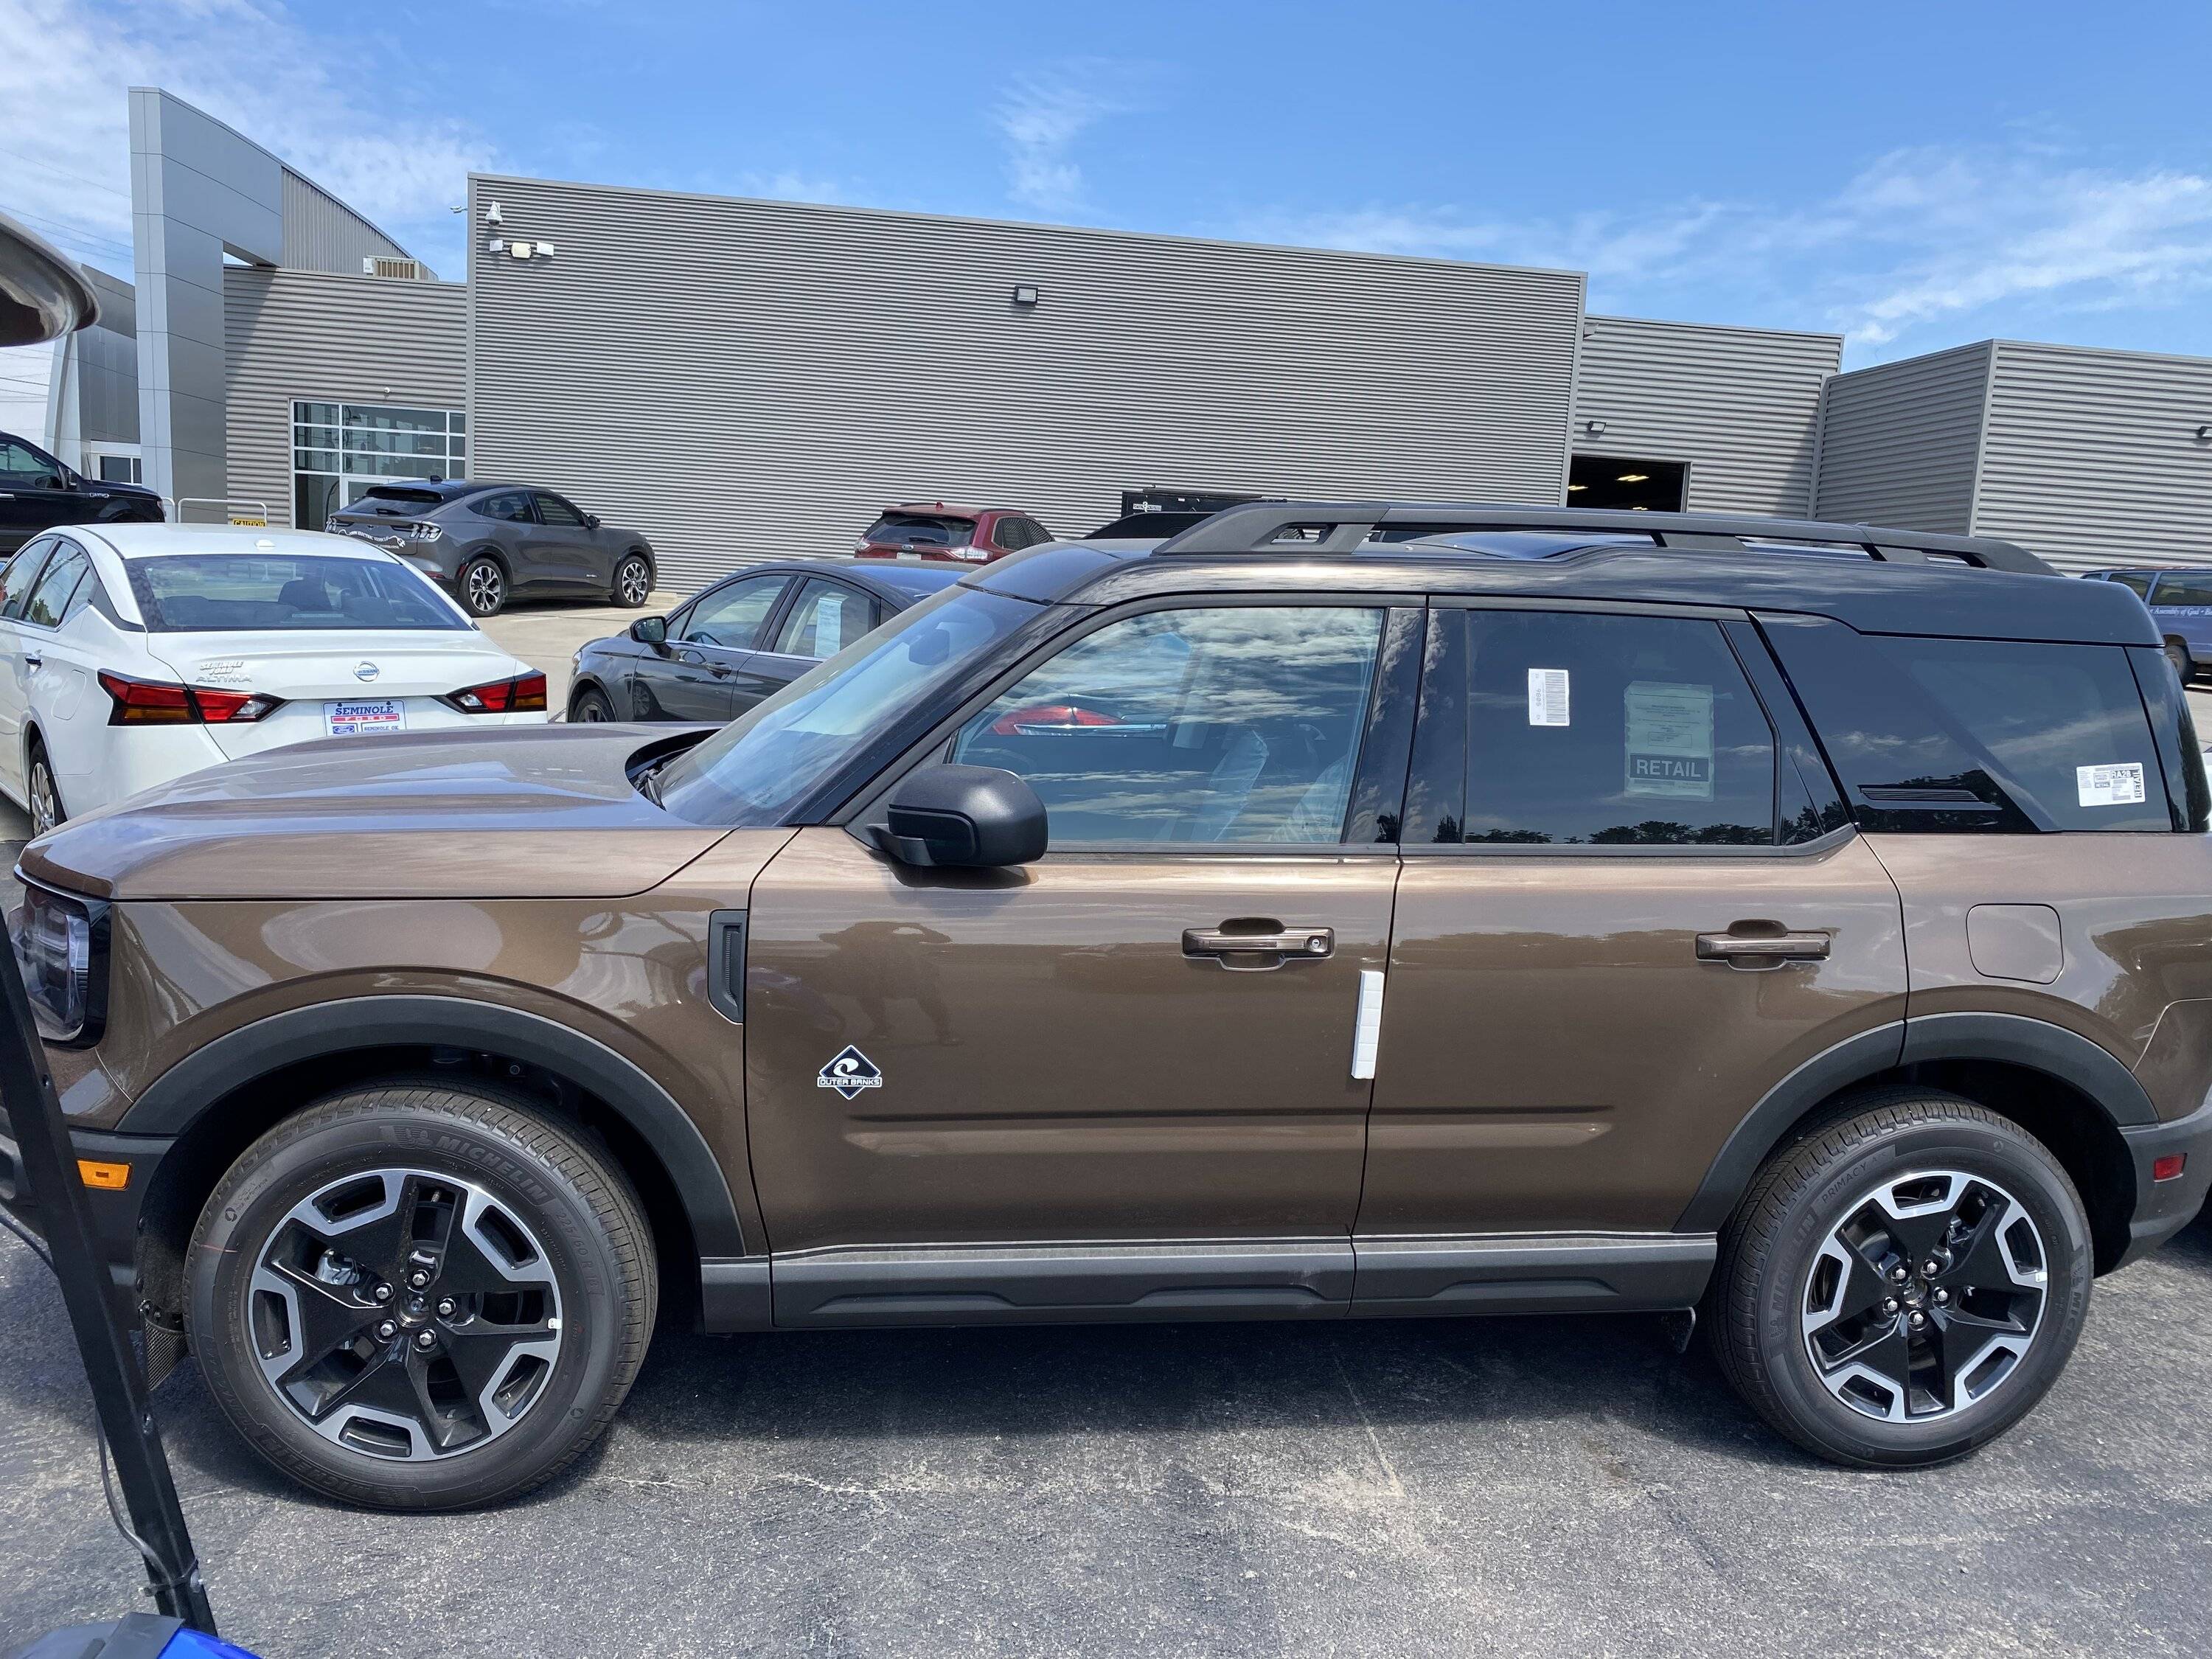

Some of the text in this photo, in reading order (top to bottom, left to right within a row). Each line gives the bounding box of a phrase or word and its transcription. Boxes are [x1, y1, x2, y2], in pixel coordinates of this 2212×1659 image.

[2154, 608, 2180, 616] Assembly
[2188, 608, 2200, 616] God
[335, 706, 394, 715] SEMINOLE
[1637, 759, 1701, 777] RETAIL
[437, 1136, 548, 1200] MICHELIN
[1773, 1213, 1817, 1312] MICHLIN
[1822, 1161, 1867, 1204] PRIMACY
